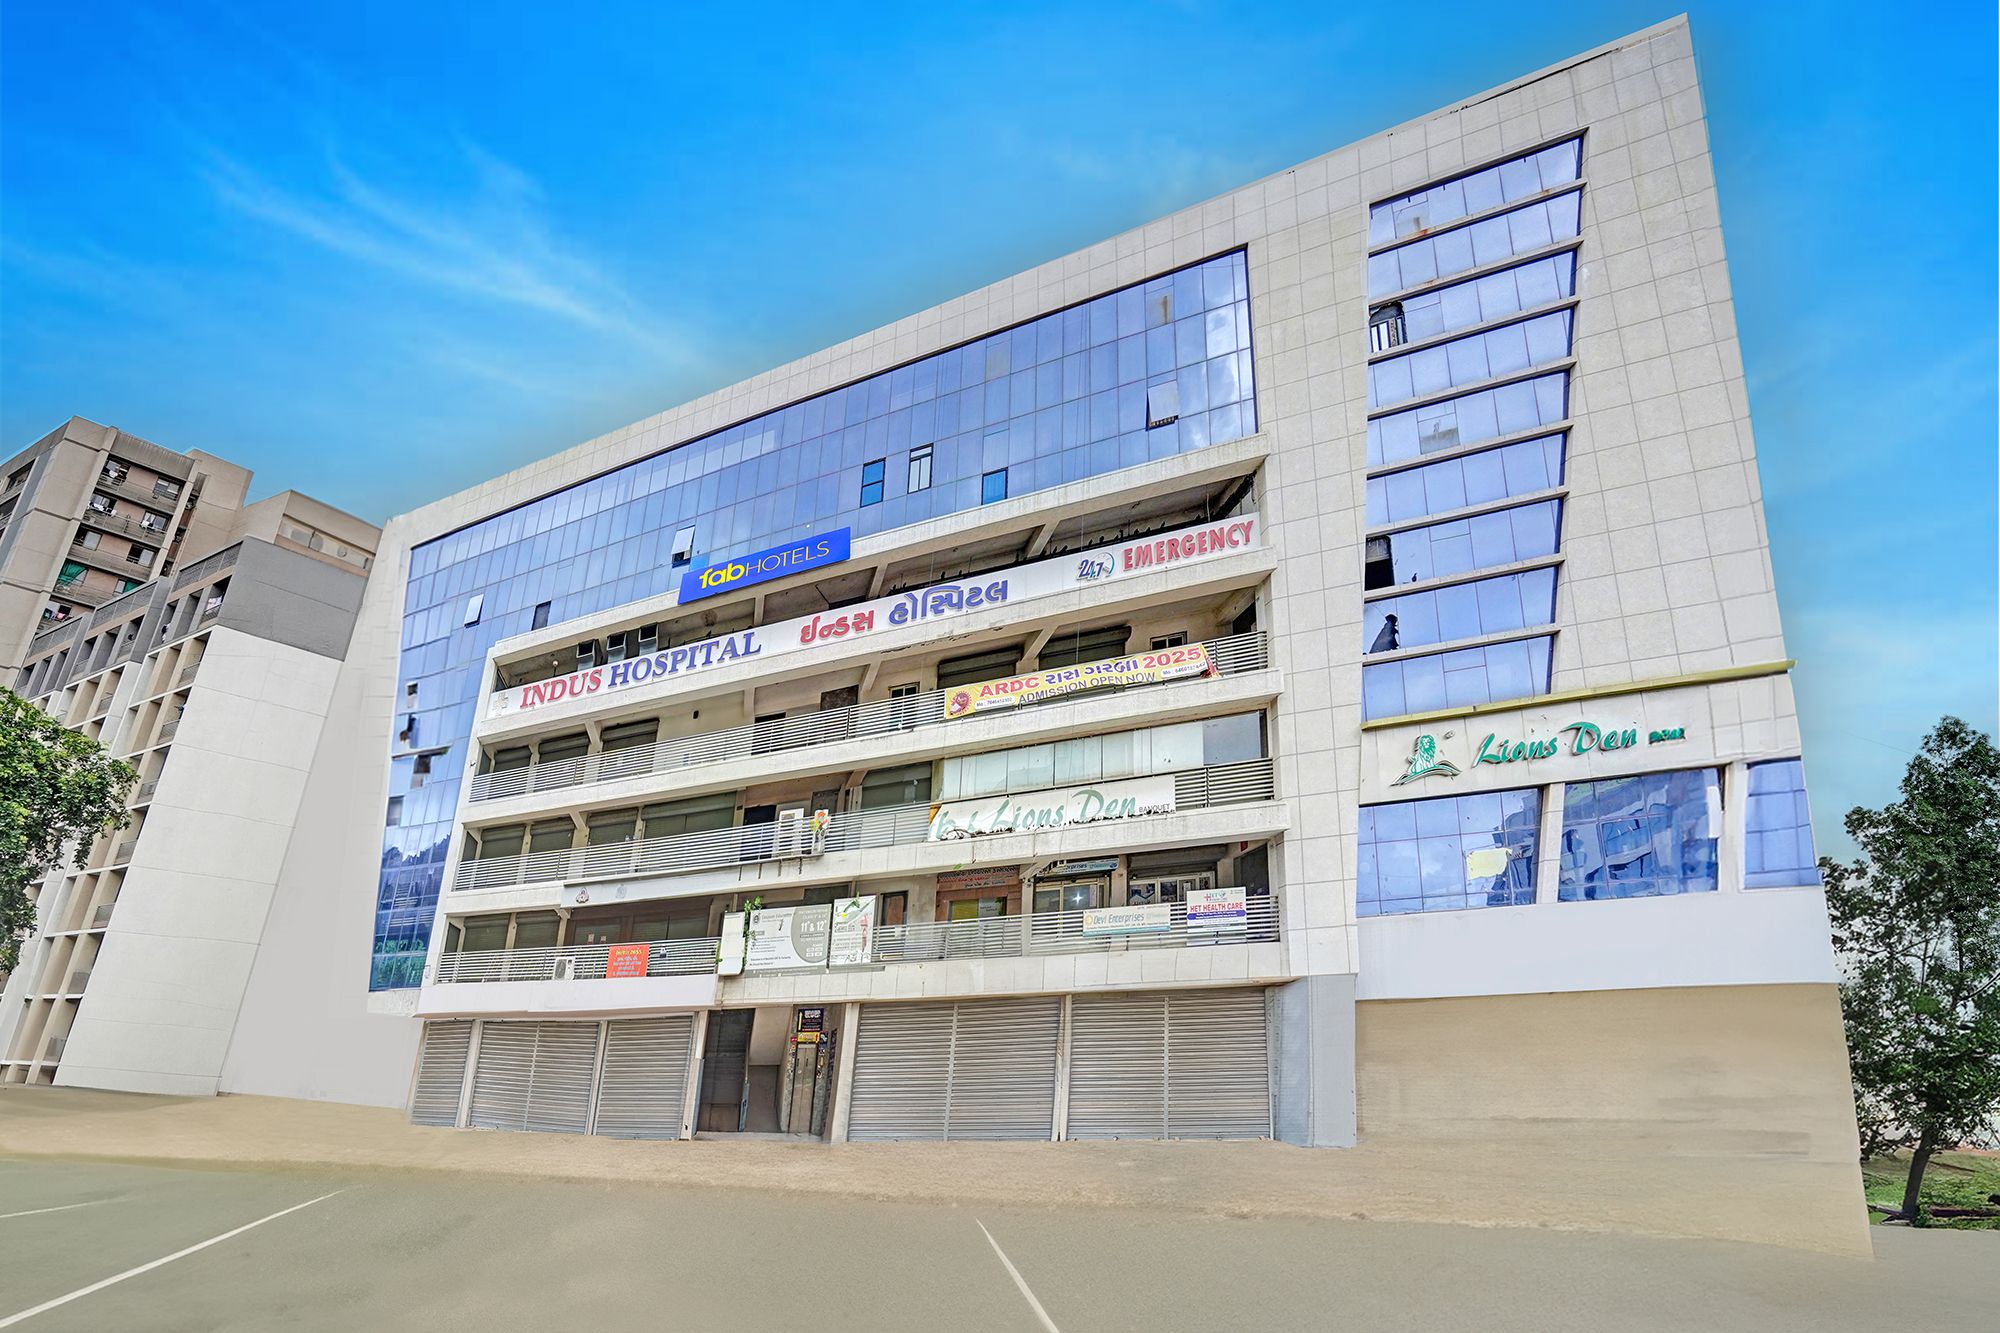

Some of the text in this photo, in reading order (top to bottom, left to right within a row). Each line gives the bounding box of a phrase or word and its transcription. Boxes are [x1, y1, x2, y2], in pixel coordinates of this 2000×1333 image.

[698, 540, 830, 589] fabHOTELS
[1122, 519, 1255, 571] EMERGENCY
[888, 579, 1008, 627] હોસ્પિટલ
[519, 632, 762, 709] INDUS HOSPITAL
[979, 676, 1040, 698] ARDC
[1142, 647, 1201, 669] 2025
[1018, 679, 1087, 703] ADMISSION
[1090, 675, 1123, 687] OPEN
[1126, 670, 1156, 683] NOW
[1472, 732, 1559, 769] Lions
[1560, 721, 1637, 756] Den
[991, 798, 1065, 829] Lions
[1072, 789, 1136, 821] Den
[1190, 901, 1243, 913] HET HEALTH CARE
